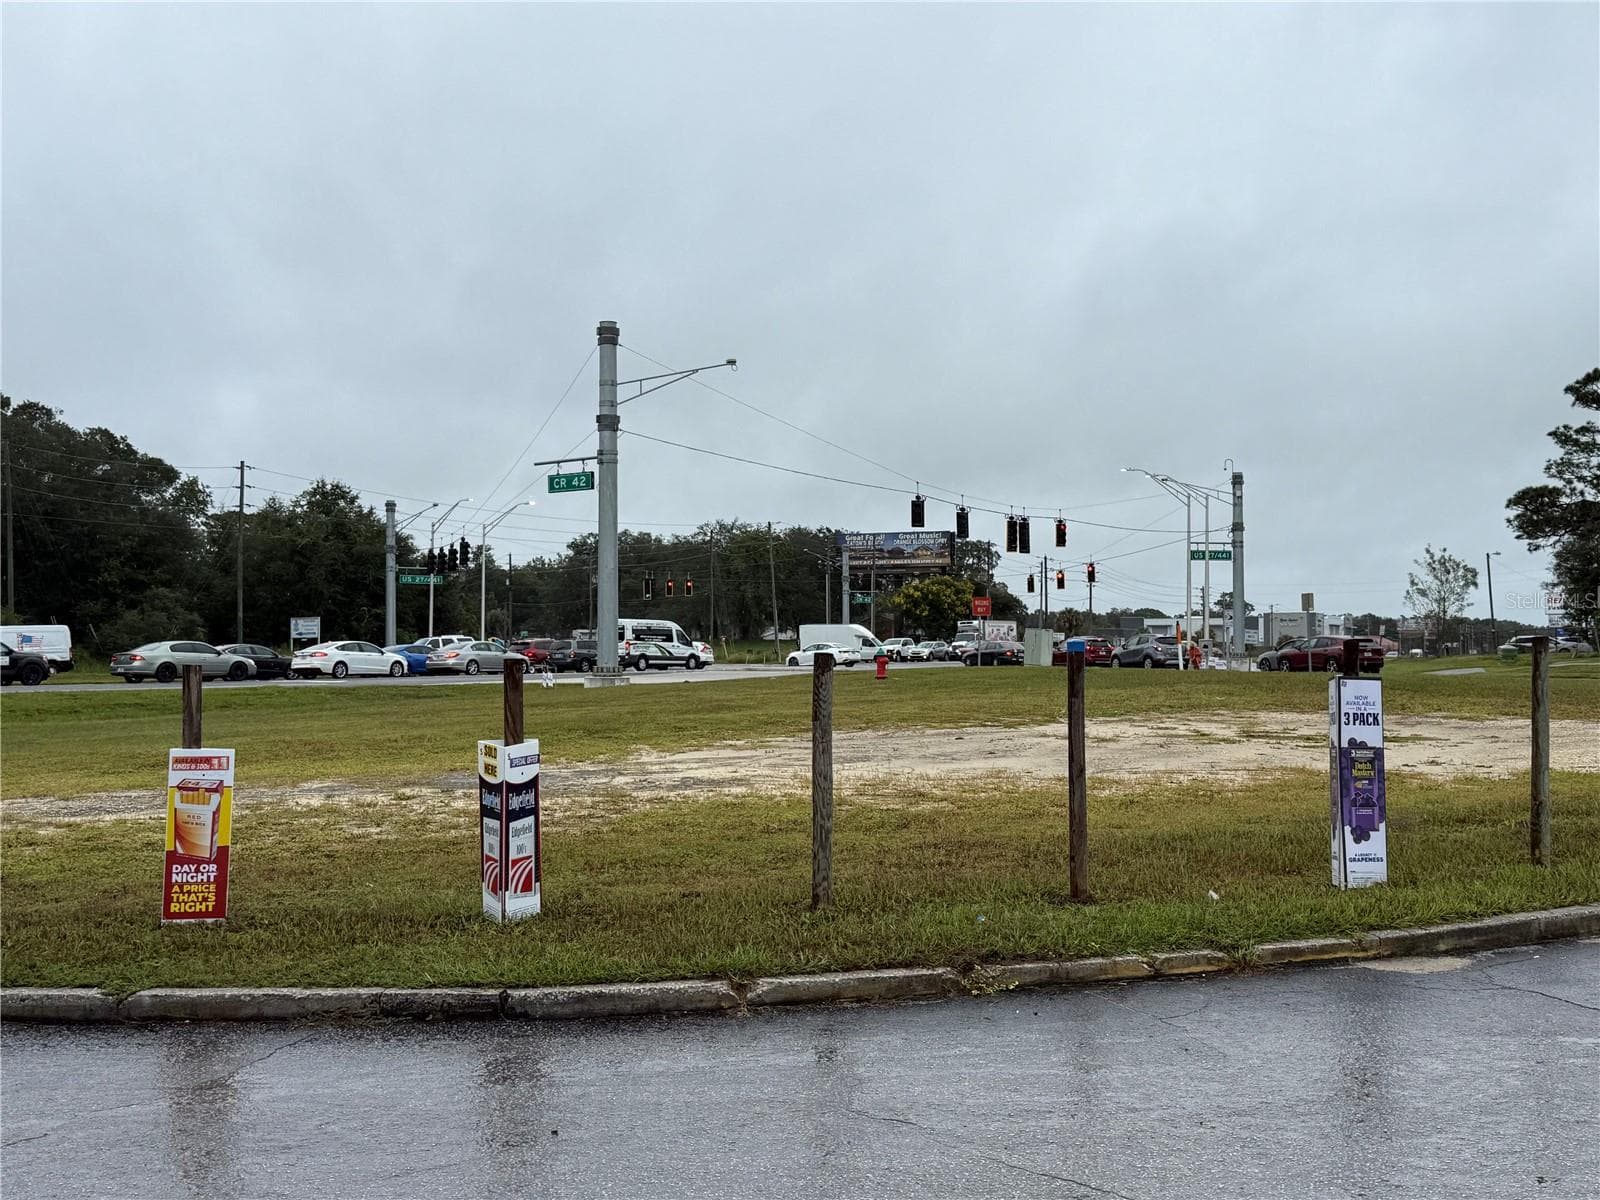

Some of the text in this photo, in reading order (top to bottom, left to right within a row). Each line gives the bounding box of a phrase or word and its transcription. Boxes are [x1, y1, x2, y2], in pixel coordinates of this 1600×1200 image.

[553, 476, 586, 489] CR 42
[1343, 712, 1380, 726] 3 PACK
[484, 744, 497, 759] SOLD
[484, 763, 497, 778] HERE
[508, 788, 535, 811] Edgefield
[172, 863, 217, 873] DAY OR
[171, 872, 218, 883] NIGHT
[171, 884, 217, 893] A PRICE
[170, 892, 216, 902] THAT'S
[170, 902, 216, 913] RIGHT
